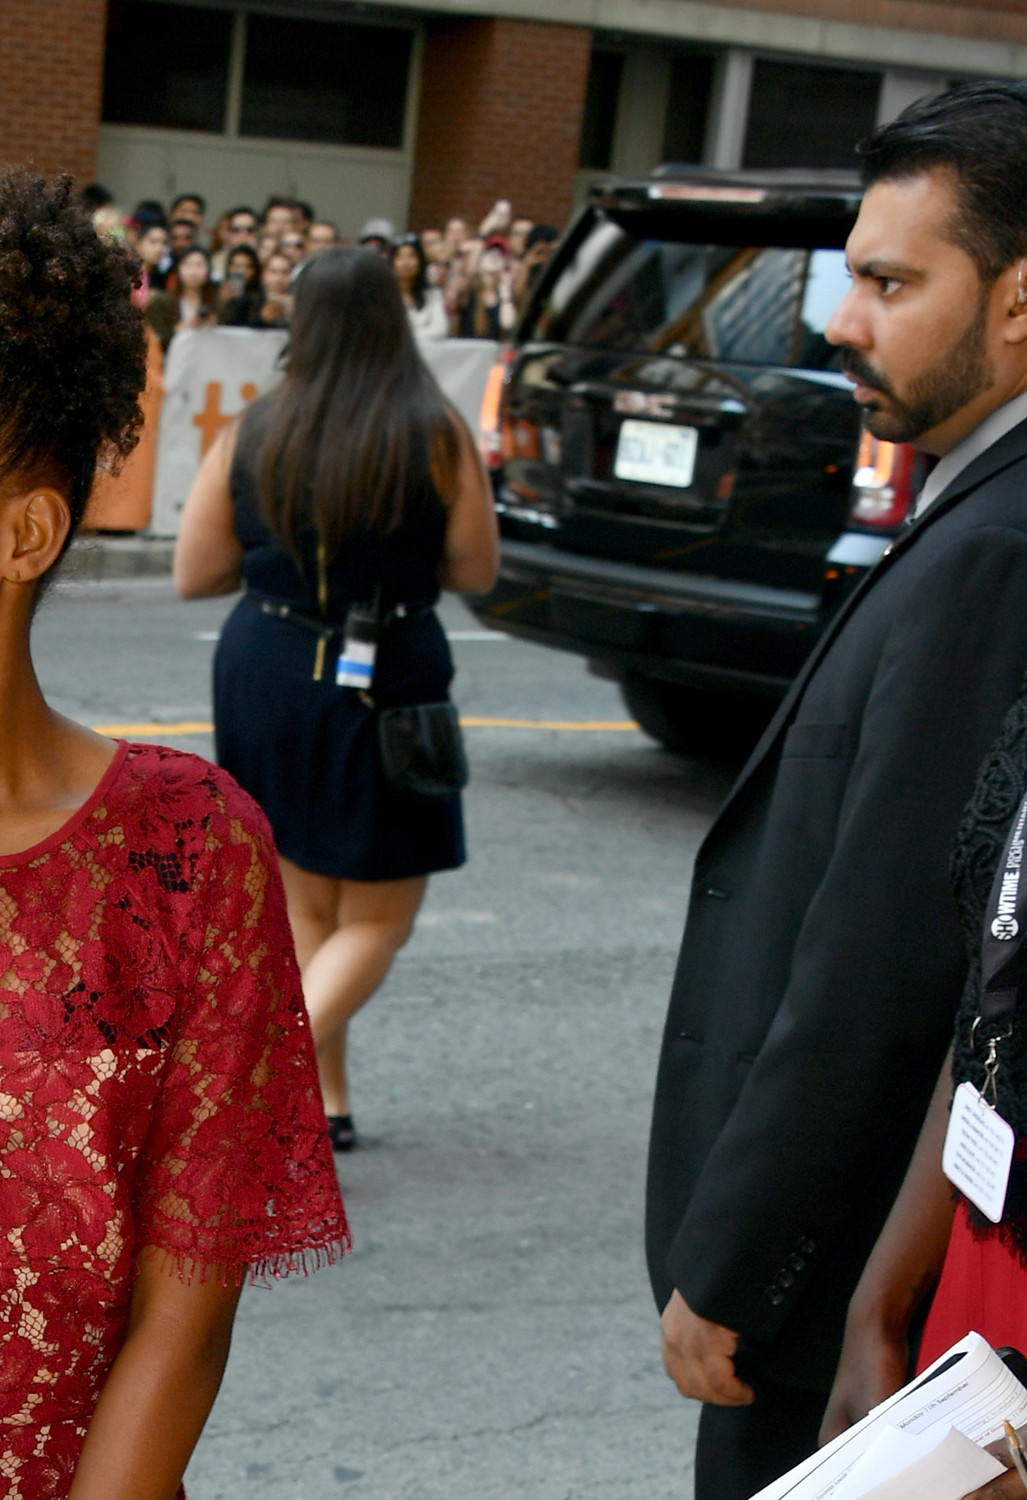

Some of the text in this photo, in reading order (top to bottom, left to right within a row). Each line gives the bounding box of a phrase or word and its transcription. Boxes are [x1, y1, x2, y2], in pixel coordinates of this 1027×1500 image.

[991, 871, 1020, 940] SHOWTIME
[899, 1411, 924, 1429] Monday
[937, 1382, 969, 1405] September
